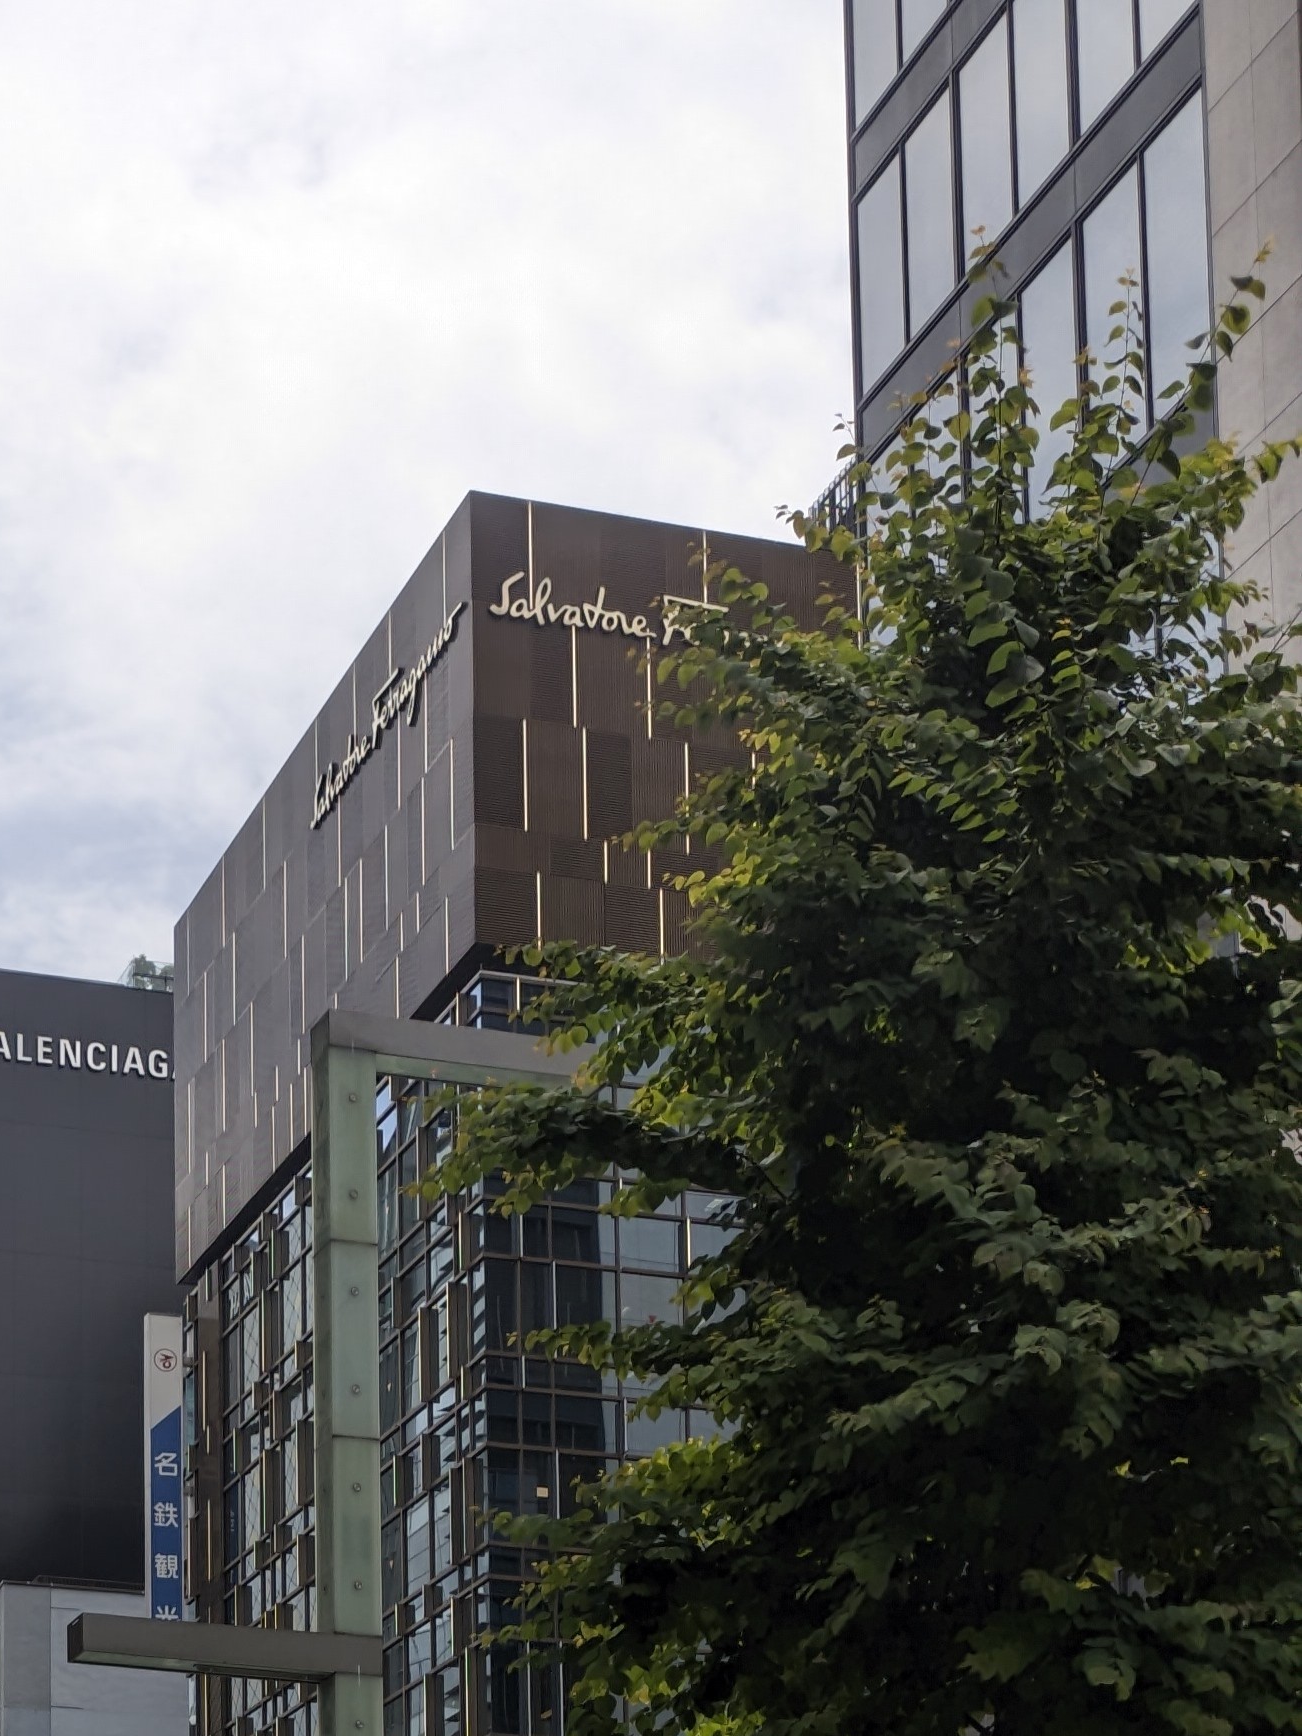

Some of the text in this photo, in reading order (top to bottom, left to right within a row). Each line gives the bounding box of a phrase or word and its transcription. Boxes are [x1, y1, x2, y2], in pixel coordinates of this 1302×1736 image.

[490, 571, 656, 637] Salvatore
[310, 602, 466, 830] Salvatore Ferragamo
